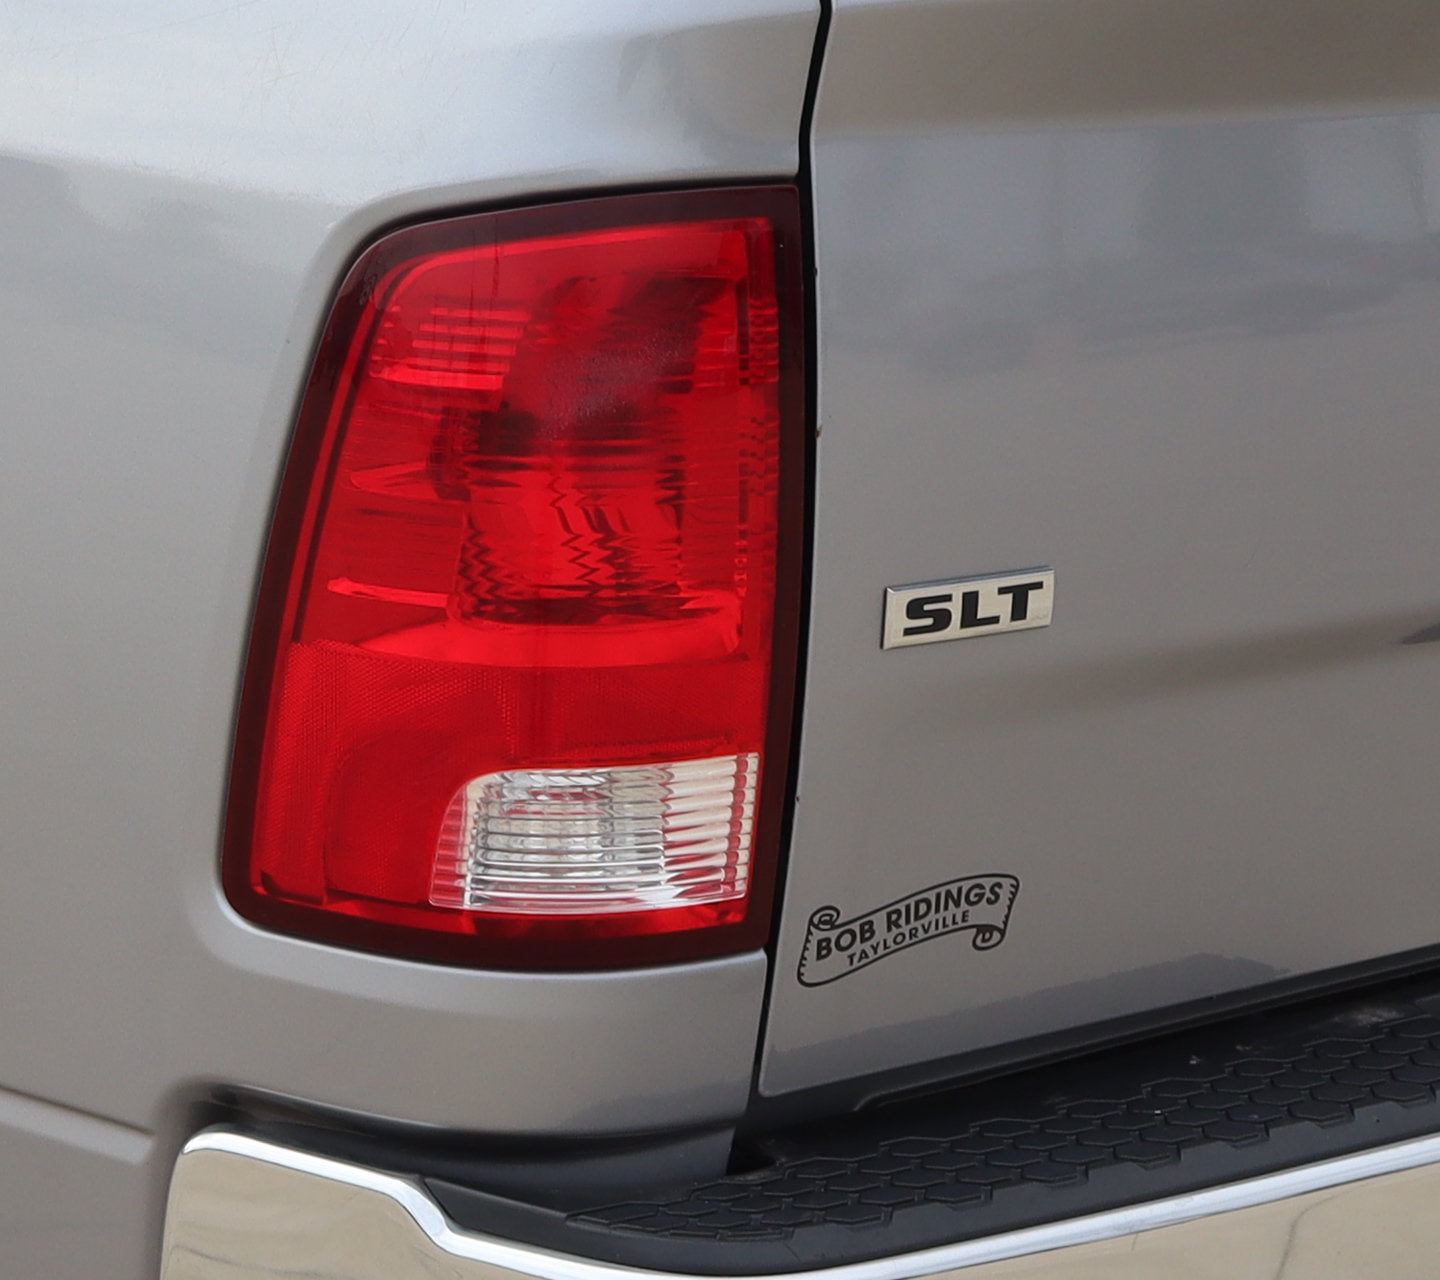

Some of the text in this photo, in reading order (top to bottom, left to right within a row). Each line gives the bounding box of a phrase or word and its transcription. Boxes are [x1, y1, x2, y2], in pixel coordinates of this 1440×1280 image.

[902, 580, 1044, 637] SLT
[815, 880, 1004, 962] BOB RIDINGS
[847, 910, 971, 967] TAYLORVILLE
